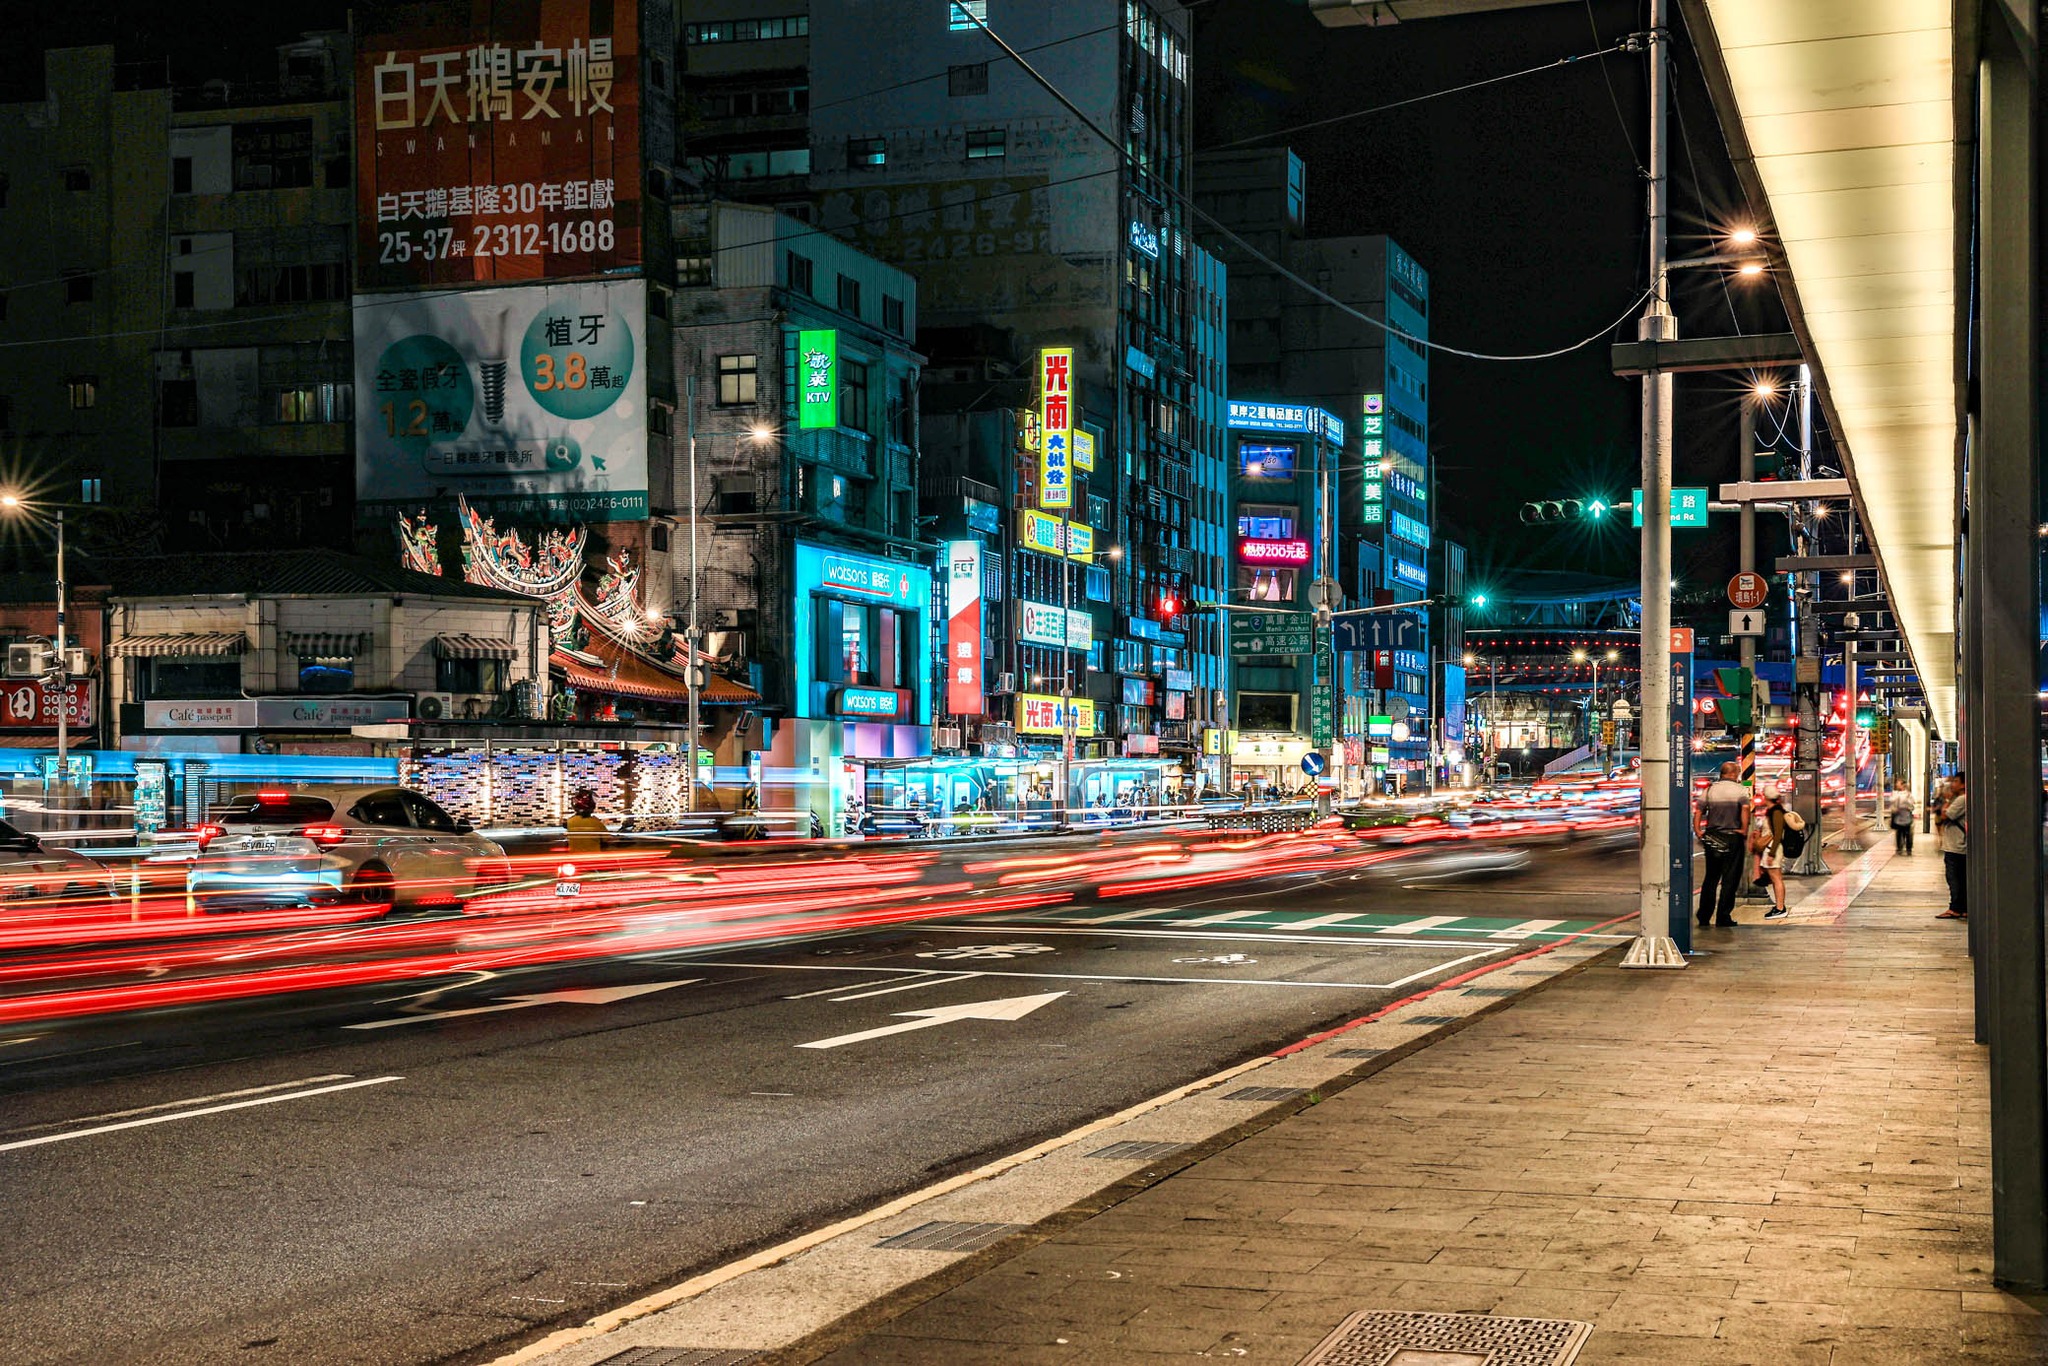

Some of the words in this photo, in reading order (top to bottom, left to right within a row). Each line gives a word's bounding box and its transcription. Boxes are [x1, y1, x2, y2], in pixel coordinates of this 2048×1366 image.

[373, 38, 615, 131] 白天鵝安幔
[376, 179, 615, 223] 白天鵝基隆30年鉅獻
[473, 219, 615, 257] 2312-1688
[545, 314, 605, 347] 植牙
[376, 365, 462, 392] 全瓷假牙
[806, 392, 831, 403] KTV
[1683, 512, 1696, 521] Rd.
[829, 564, 868, 585] watsons
[1265, 635, 1309, 646] 高速公路
[169, 707, 195, 721] Café
[197, 714, 232, 723] passeport
[293, 707, 324, 721] Café
